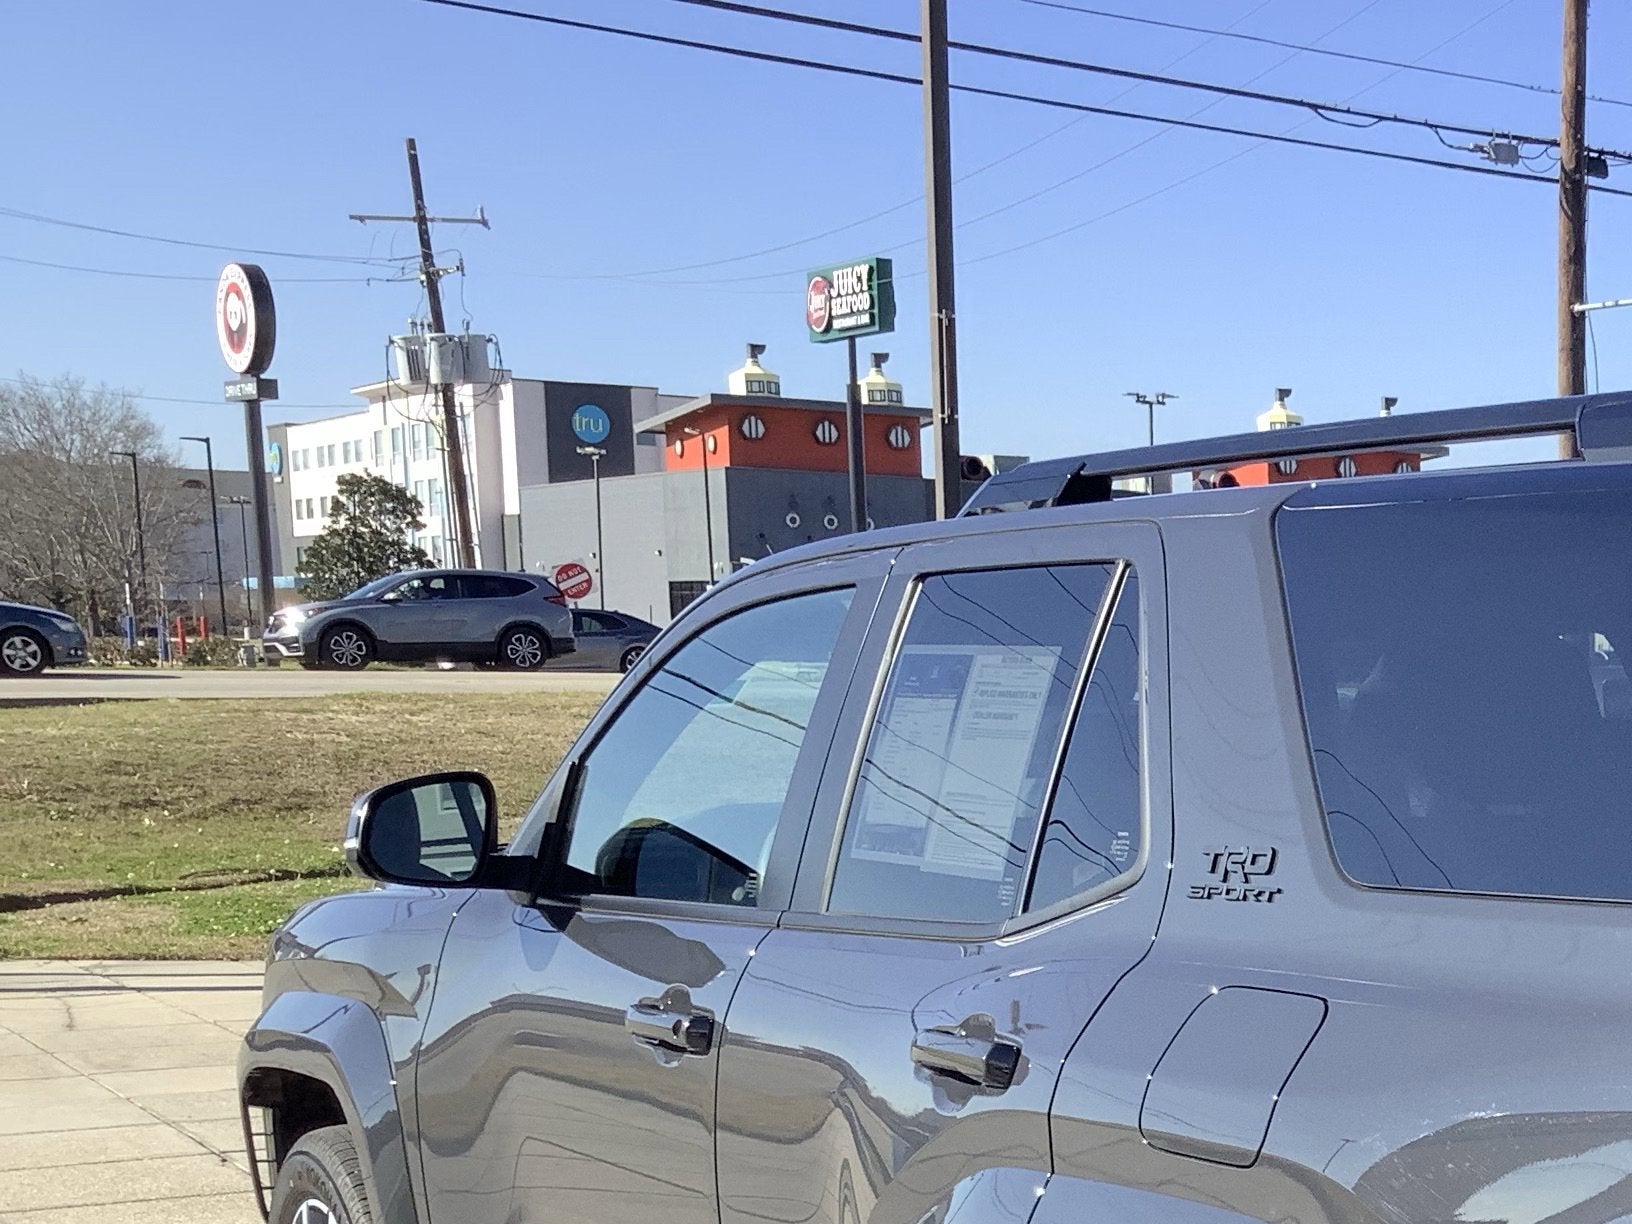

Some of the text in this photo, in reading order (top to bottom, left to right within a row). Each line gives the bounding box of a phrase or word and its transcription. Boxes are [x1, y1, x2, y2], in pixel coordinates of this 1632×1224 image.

[830, 264, 869, 297] JUICY
[831, 292, 870, 317] SEAFOOD
[573, 413, 602, 432] tru
[567, 582, 588, 595] ENTER
[1201, 845, 1278, 884] TRD
[1186, 884, 1284, 903] SPORT
